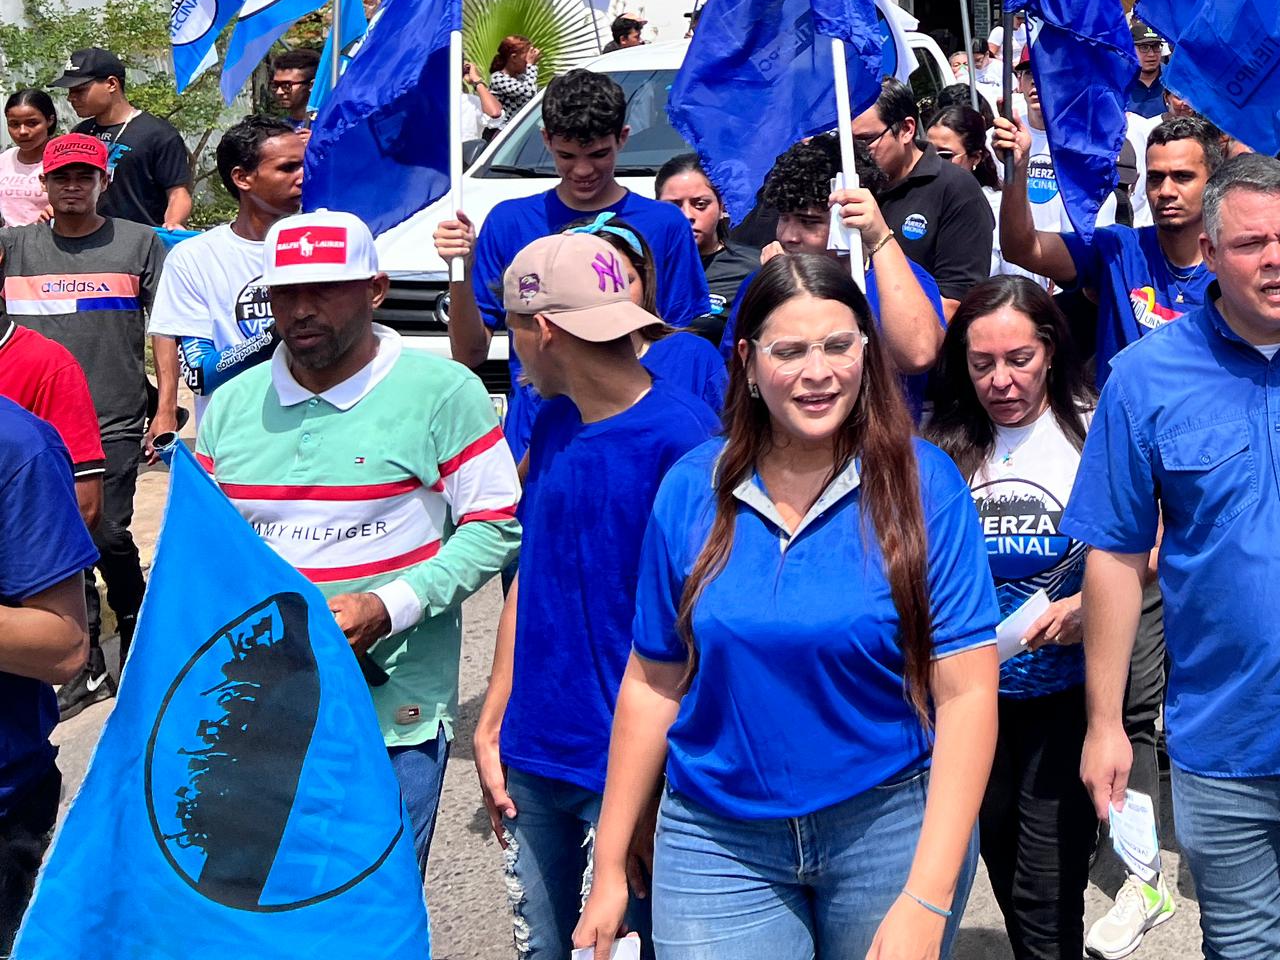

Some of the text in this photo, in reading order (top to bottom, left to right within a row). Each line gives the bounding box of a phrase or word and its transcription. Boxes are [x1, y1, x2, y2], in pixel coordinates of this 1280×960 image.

[53, 141, 97, 154] Human
[591, 251, 624, 293] NY
[41, 279, 95, 293] adidas
[292, 522, 389, 540] HILFIGER
[979, 514, 1056, 535] ERZA
